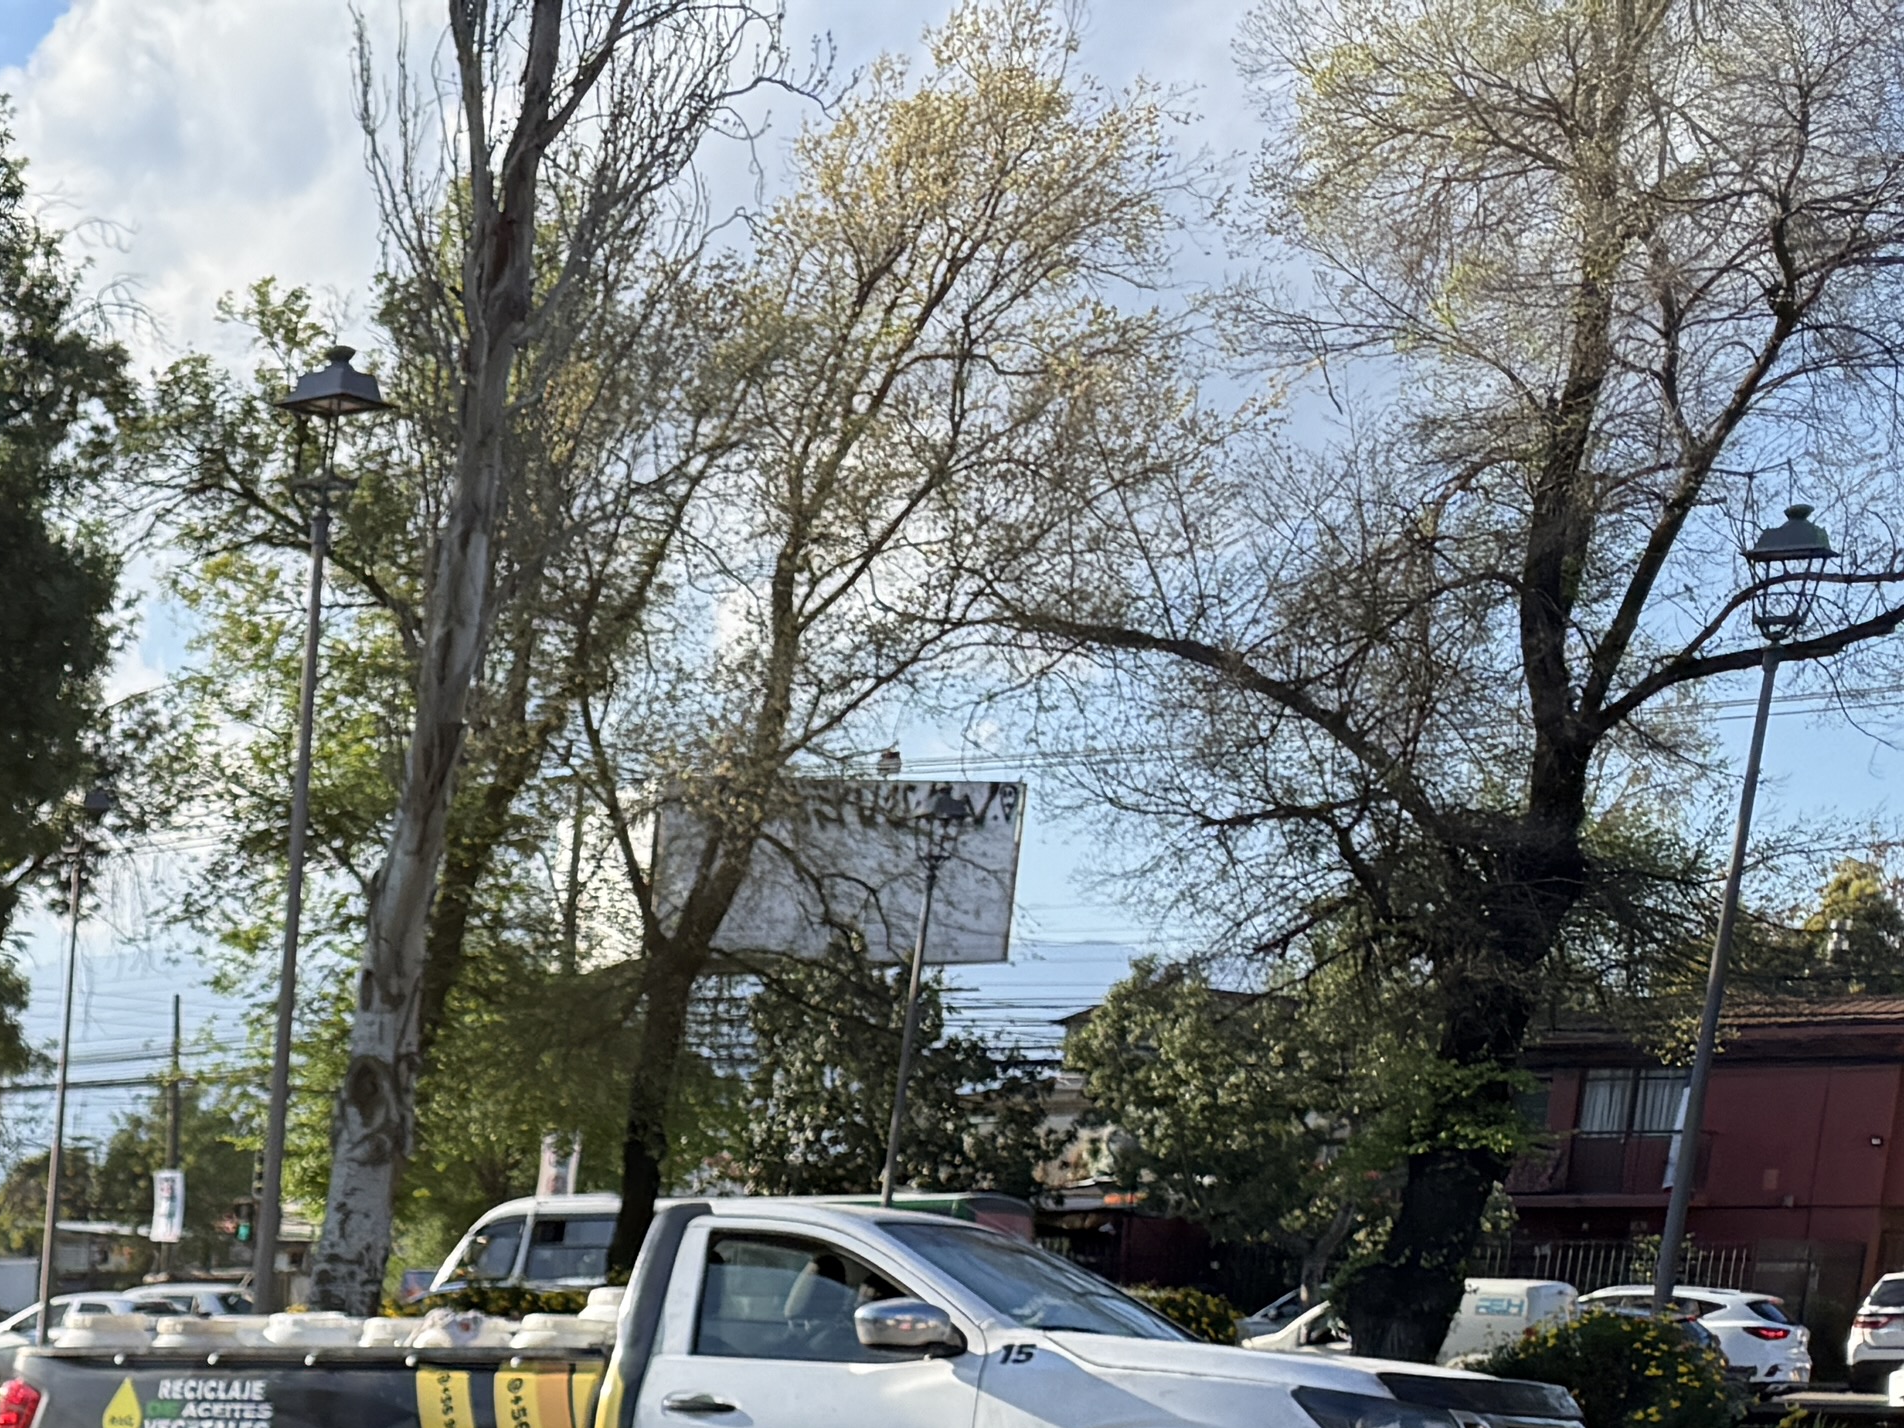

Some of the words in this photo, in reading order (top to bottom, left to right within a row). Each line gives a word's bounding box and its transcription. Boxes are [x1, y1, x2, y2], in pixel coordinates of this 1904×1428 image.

[1000, 1344, 1037, 1365] 15
[157, 1379, 267, 1400] RECICLAJE
[181, 1402, 274, 1419] ACEITES
